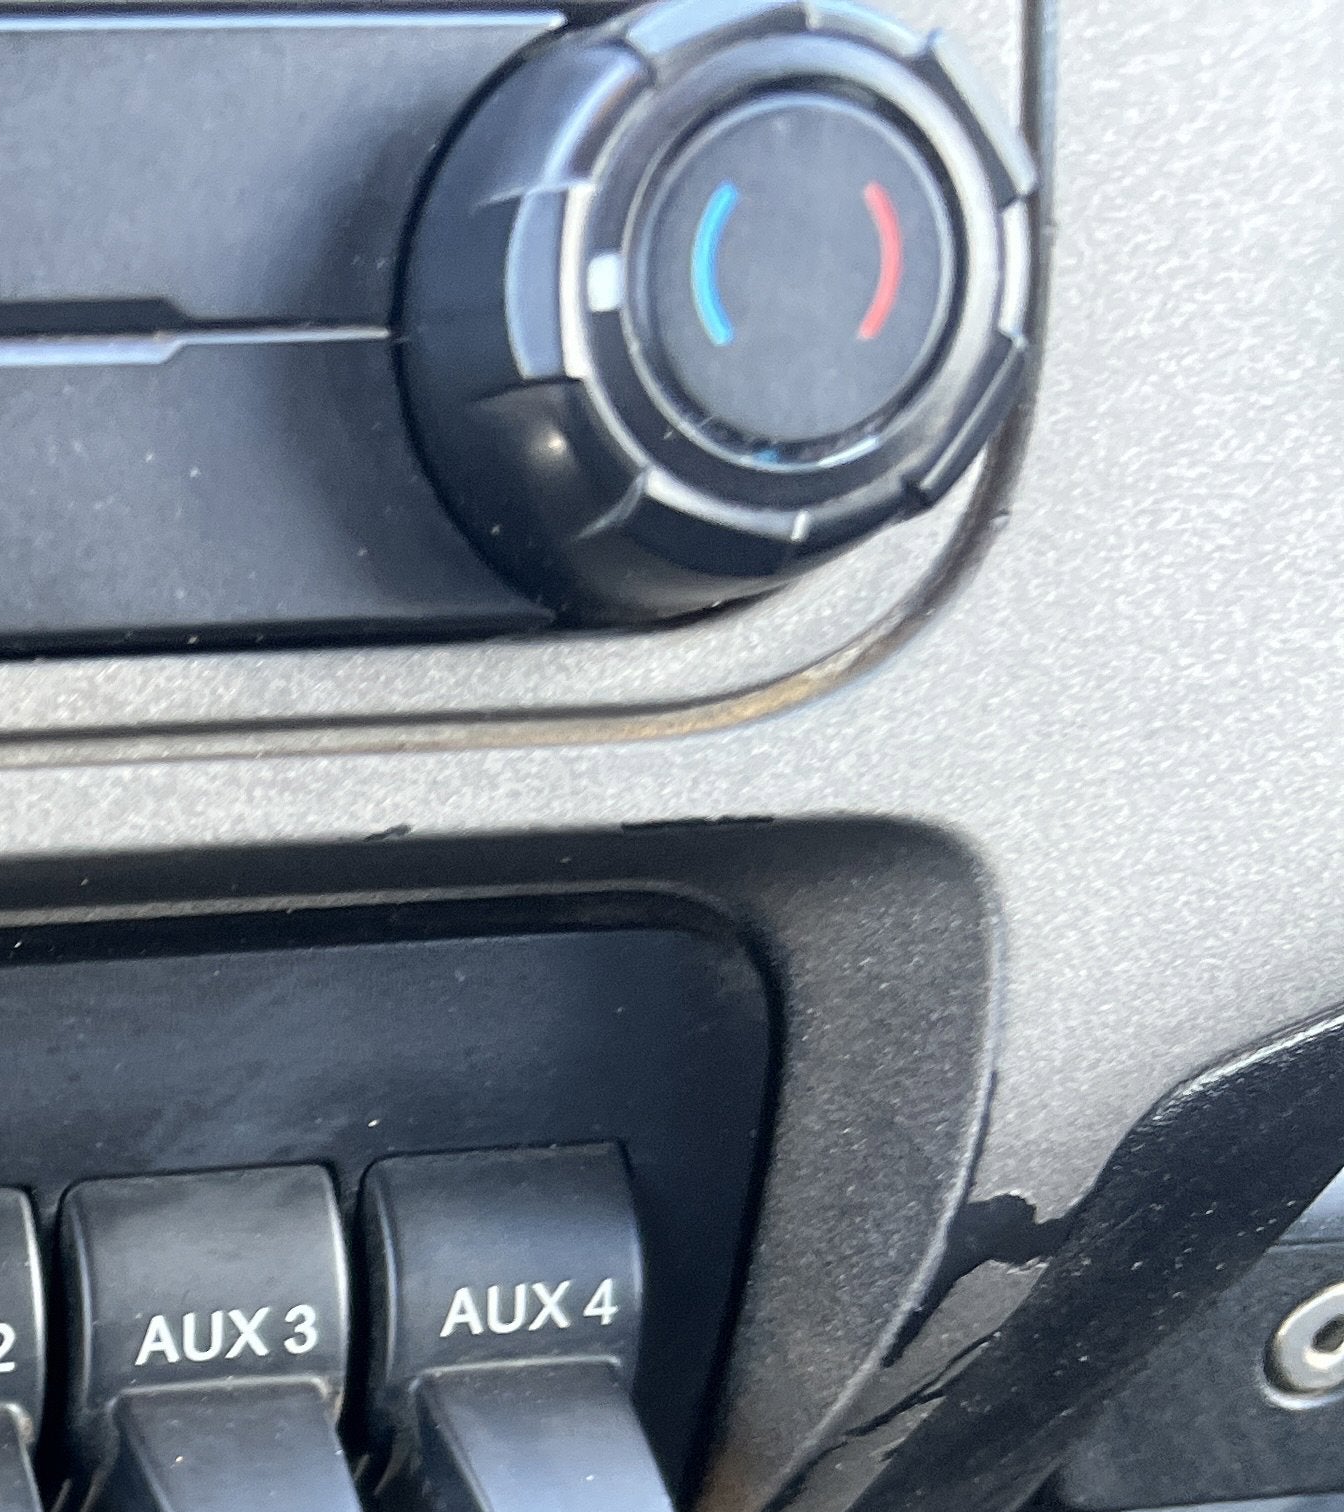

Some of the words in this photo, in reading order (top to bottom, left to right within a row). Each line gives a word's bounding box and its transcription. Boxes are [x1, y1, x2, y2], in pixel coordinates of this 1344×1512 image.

[134, 1305, 273, 1366] AUX
[283, 1303, 320, 1354] 3
[439, 1280, 572, 1338] AUX
[583, 1277, 619, 1325] 4
